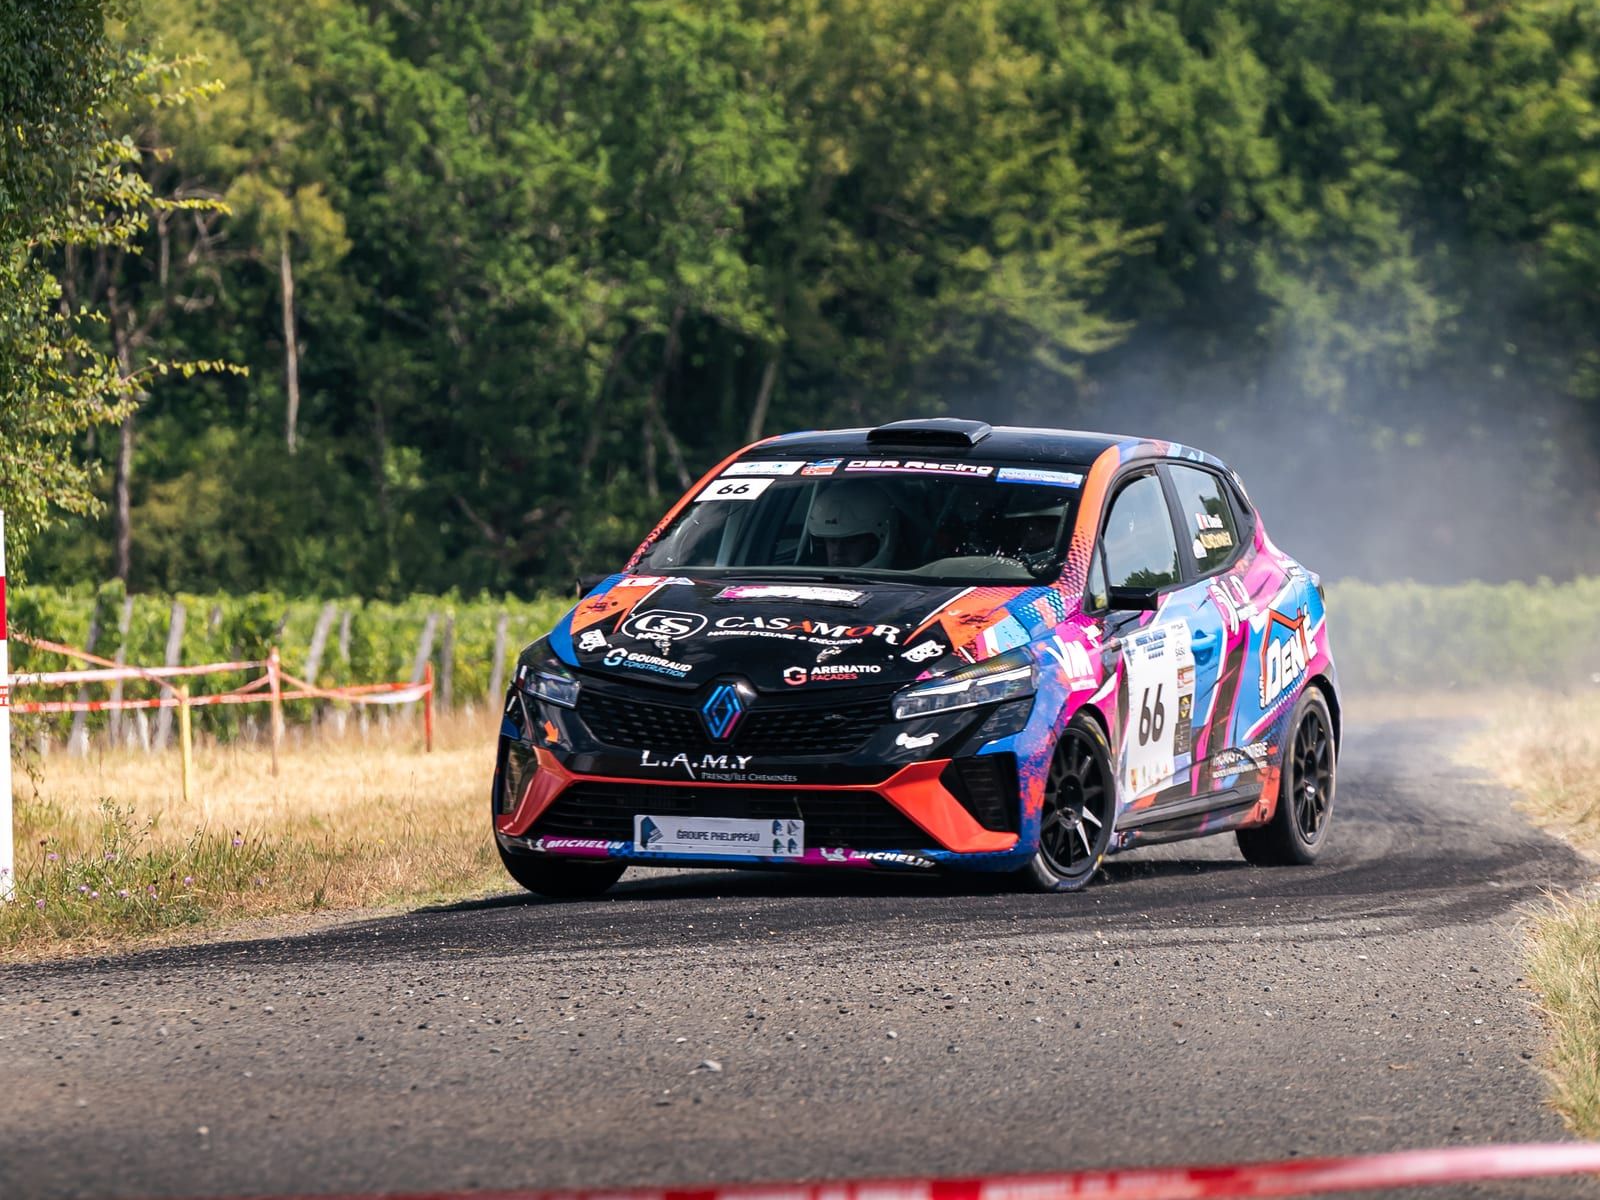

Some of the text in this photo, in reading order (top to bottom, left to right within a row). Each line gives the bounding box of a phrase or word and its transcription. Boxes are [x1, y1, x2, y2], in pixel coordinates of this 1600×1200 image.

[903, 460, 994, 475] Racing
[717, 483, 750, 495] 66
[715, 615, 901, 646] CASAMOR
[622, 659, 687, 679] CONSTRUCTION
[627, 652, 693, 673] GOURRAUD
[810, 664, 881, 675] ARENATIO
[1138, 683, 1165, 747] 66
[546, 839, 625, 849] MICHELIN
[676, 829, 760, 843] GROUPE PHELIPPEAU
[850, 851, 936, 868] MICHELIN
